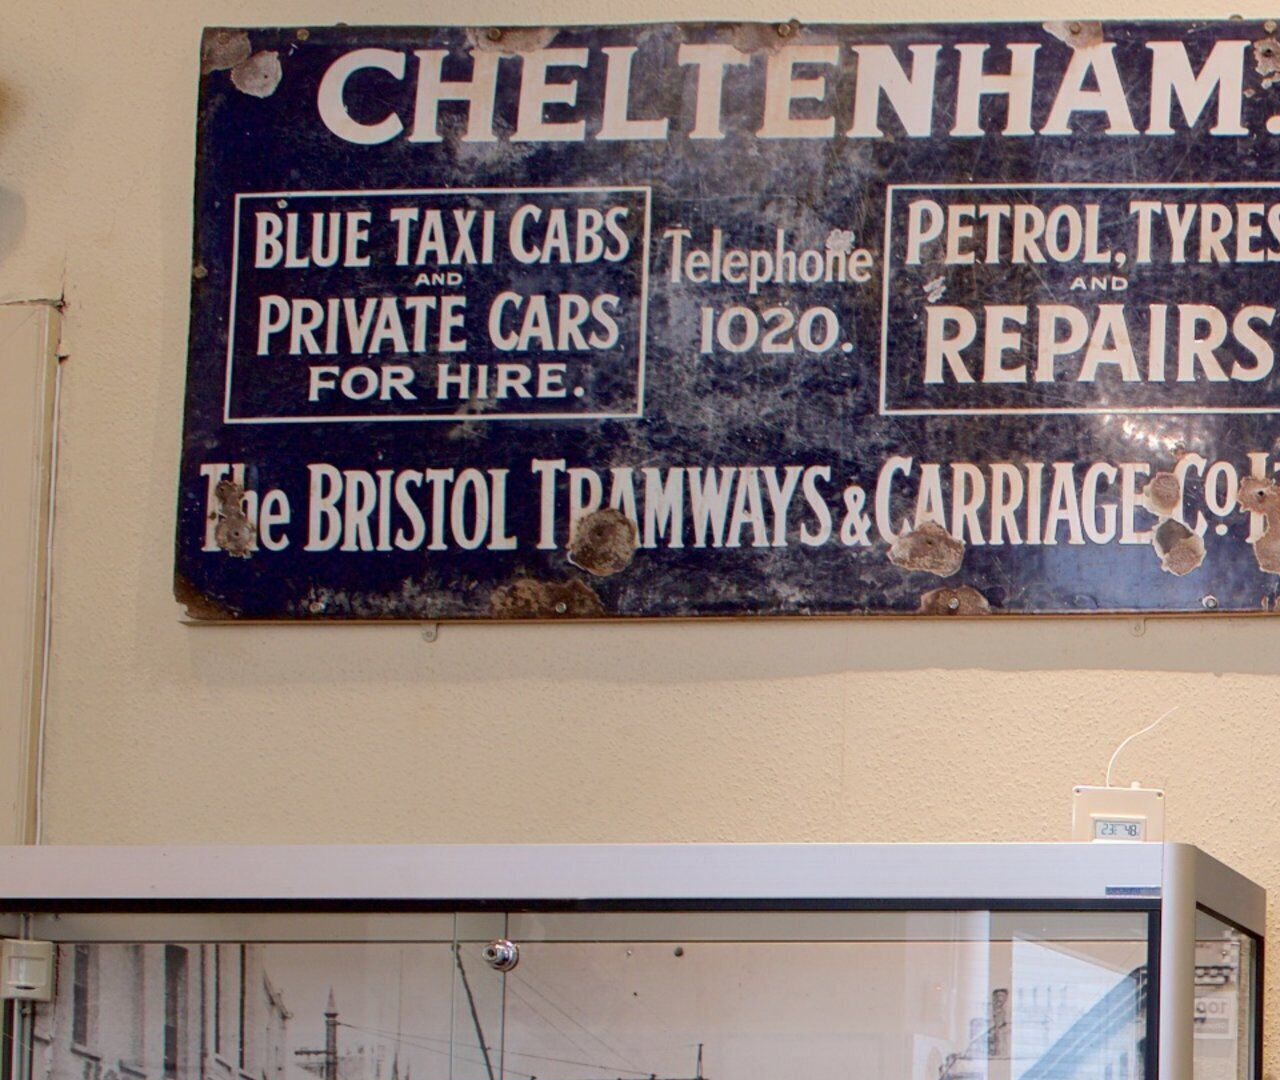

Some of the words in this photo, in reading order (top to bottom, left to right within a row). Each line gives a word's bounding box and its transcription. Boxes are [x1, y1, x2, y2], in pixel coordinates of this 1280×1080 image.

[254, 210, 373, 269] BLUE
[390, 207, 496, 267] TAXI
[508, 204, 631, 265] CABS
[662, 227, 873, 294] Telephone
[904, 200, 1127, 267] PETROL,
[414, 271, 464, 287] AND
[1070, 276, 1128, 291] AND
[256, 295, 468, 356] PRIVATE
[487, 291, 621, 352] CARS
[700, 306, 854, 355] 1020.
[922, 303, 1278, 385] REPAIRS
[307, 363, 415, 401] FOR
[436, 362, 586, 399] HIRE.
[200, 463, 291, 553] The
[304, 463, 518, 553] BRISTOL
[531, 458, 832, 550] TRAMWAYS
[874, 456, 1152, 549] CARRIAGE
